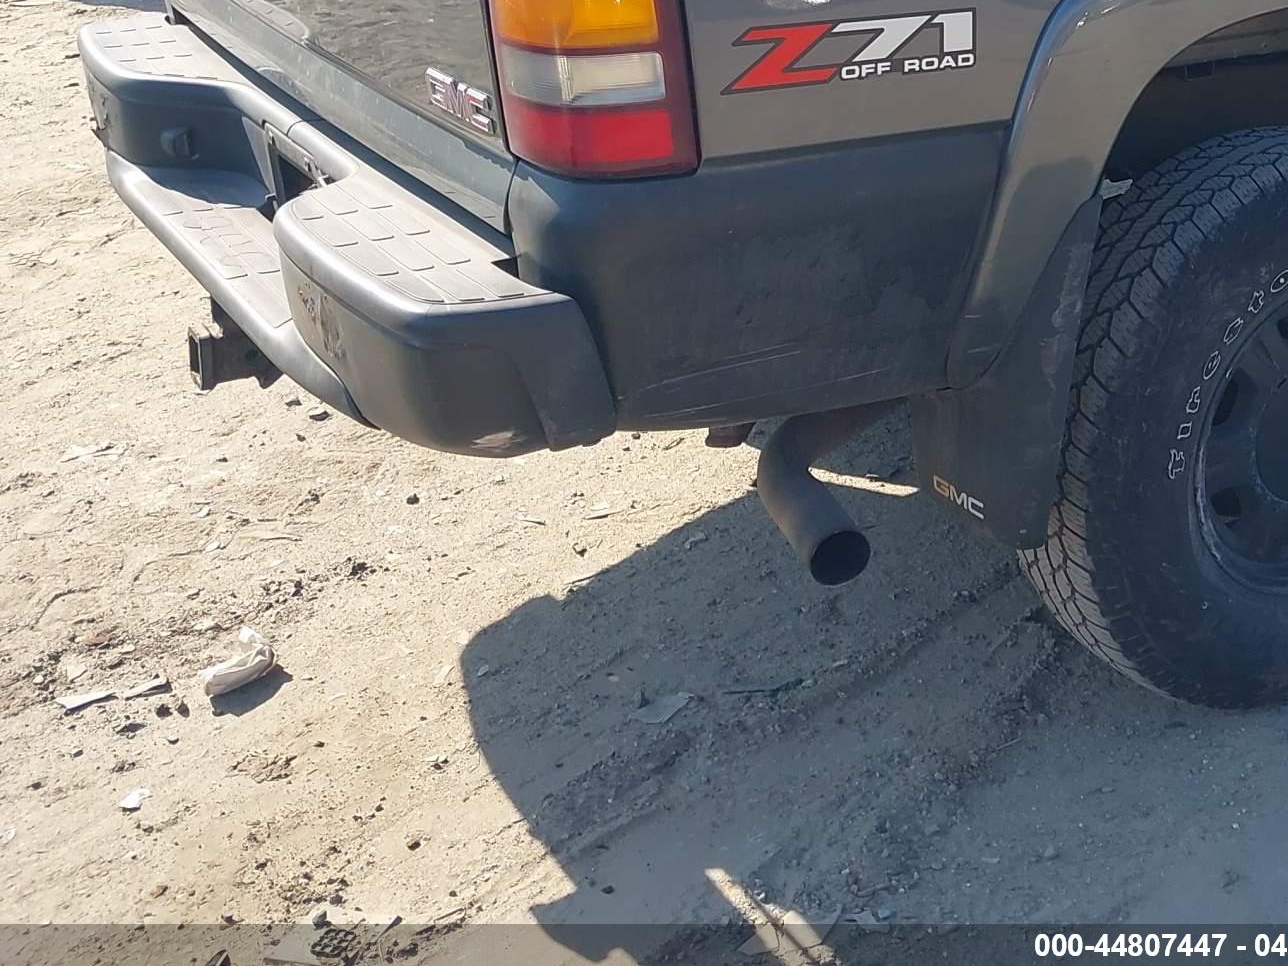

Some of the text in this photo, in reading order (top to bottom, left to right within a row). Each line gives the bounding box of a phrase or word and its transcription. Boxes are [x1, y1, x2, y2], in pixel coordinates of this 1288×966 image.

[721, 8, 976, 95] Z71
[840, 52, 975, 80] OFF ROAD
[425, 67, 494, 134] GMC
[933, 475, 984, 520] GMC
